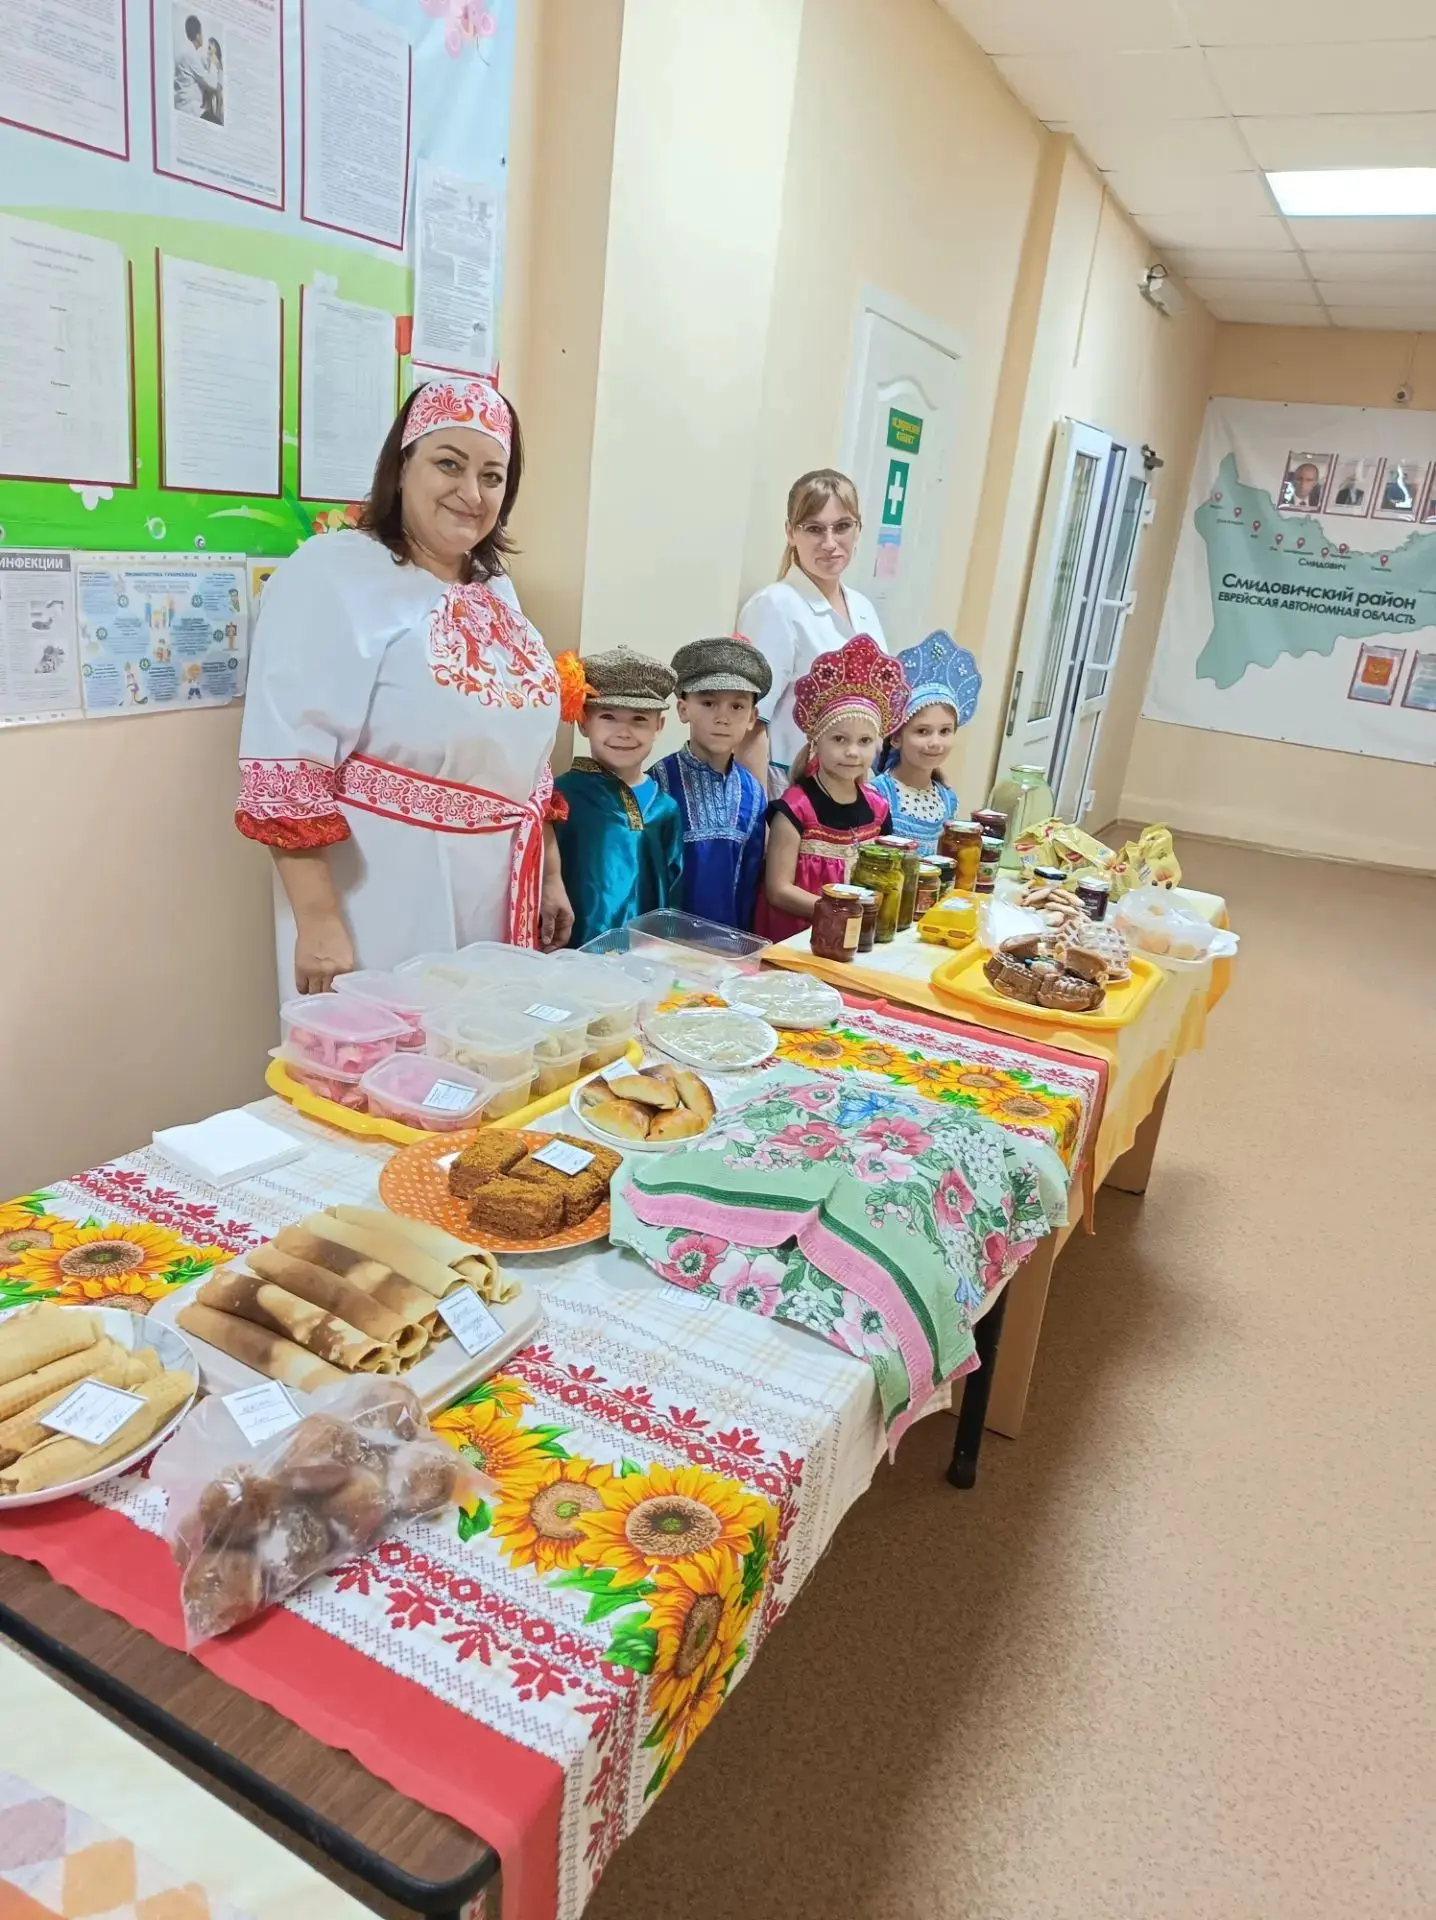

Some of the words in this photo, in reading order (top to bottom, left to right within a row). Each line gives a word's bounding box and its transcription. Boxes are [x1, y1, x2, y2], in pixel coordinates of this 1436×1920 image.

[1218, 591, 1279, 608] ЕВРЕЙСКАЯ
[1280, 599, 1360, 618] АВТОНОМНАЯ
[1361, 608, 1417, 625] ОБЛАСТЬ
[1222, 573, 1354, 602] Смидовичский
[1355, 587, 1417, 610] район
